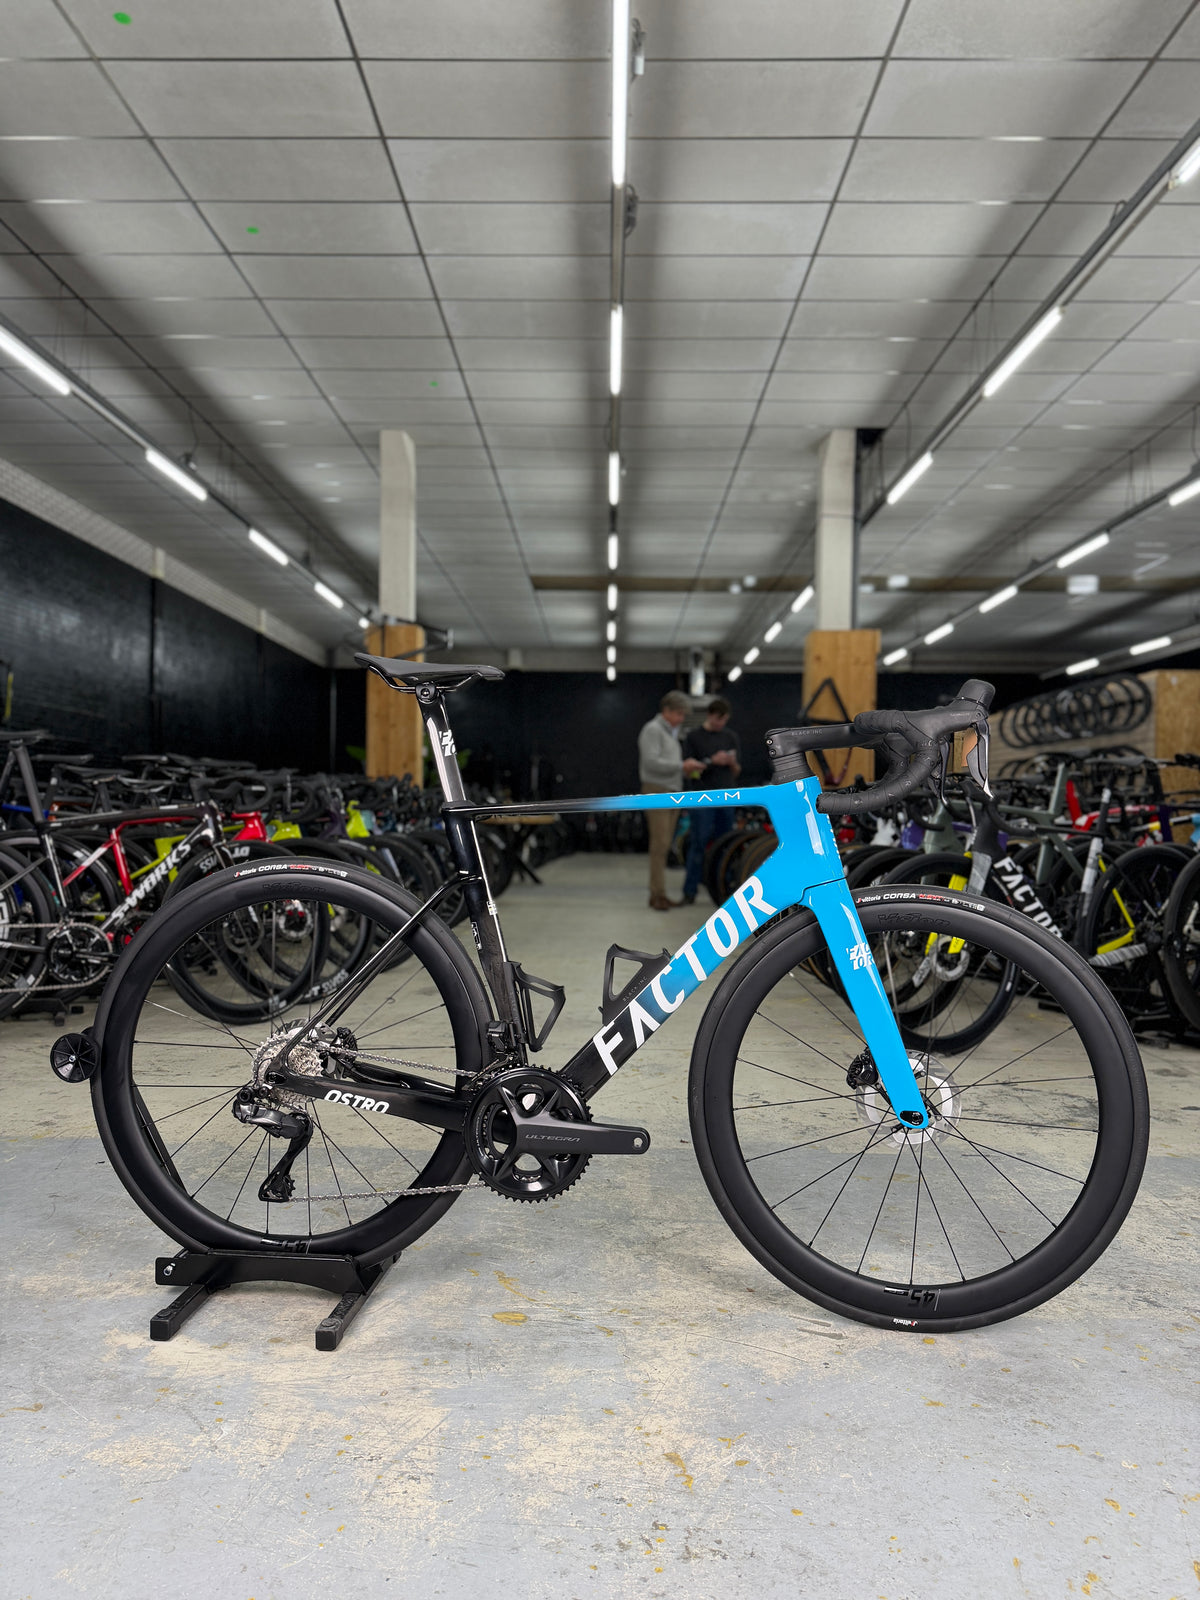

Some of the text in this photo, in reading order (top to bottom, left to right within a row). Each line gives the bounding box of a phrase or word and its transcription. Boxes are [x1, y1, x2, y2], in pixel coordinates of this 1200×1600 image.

[112, 843, 191, 926] S-WORKS
[593, 876, 778, 1076] FACTOR
[324, 1089, 390, 1113] OSTRO
[525, 1134, 581, 1142] ULTEGRA
